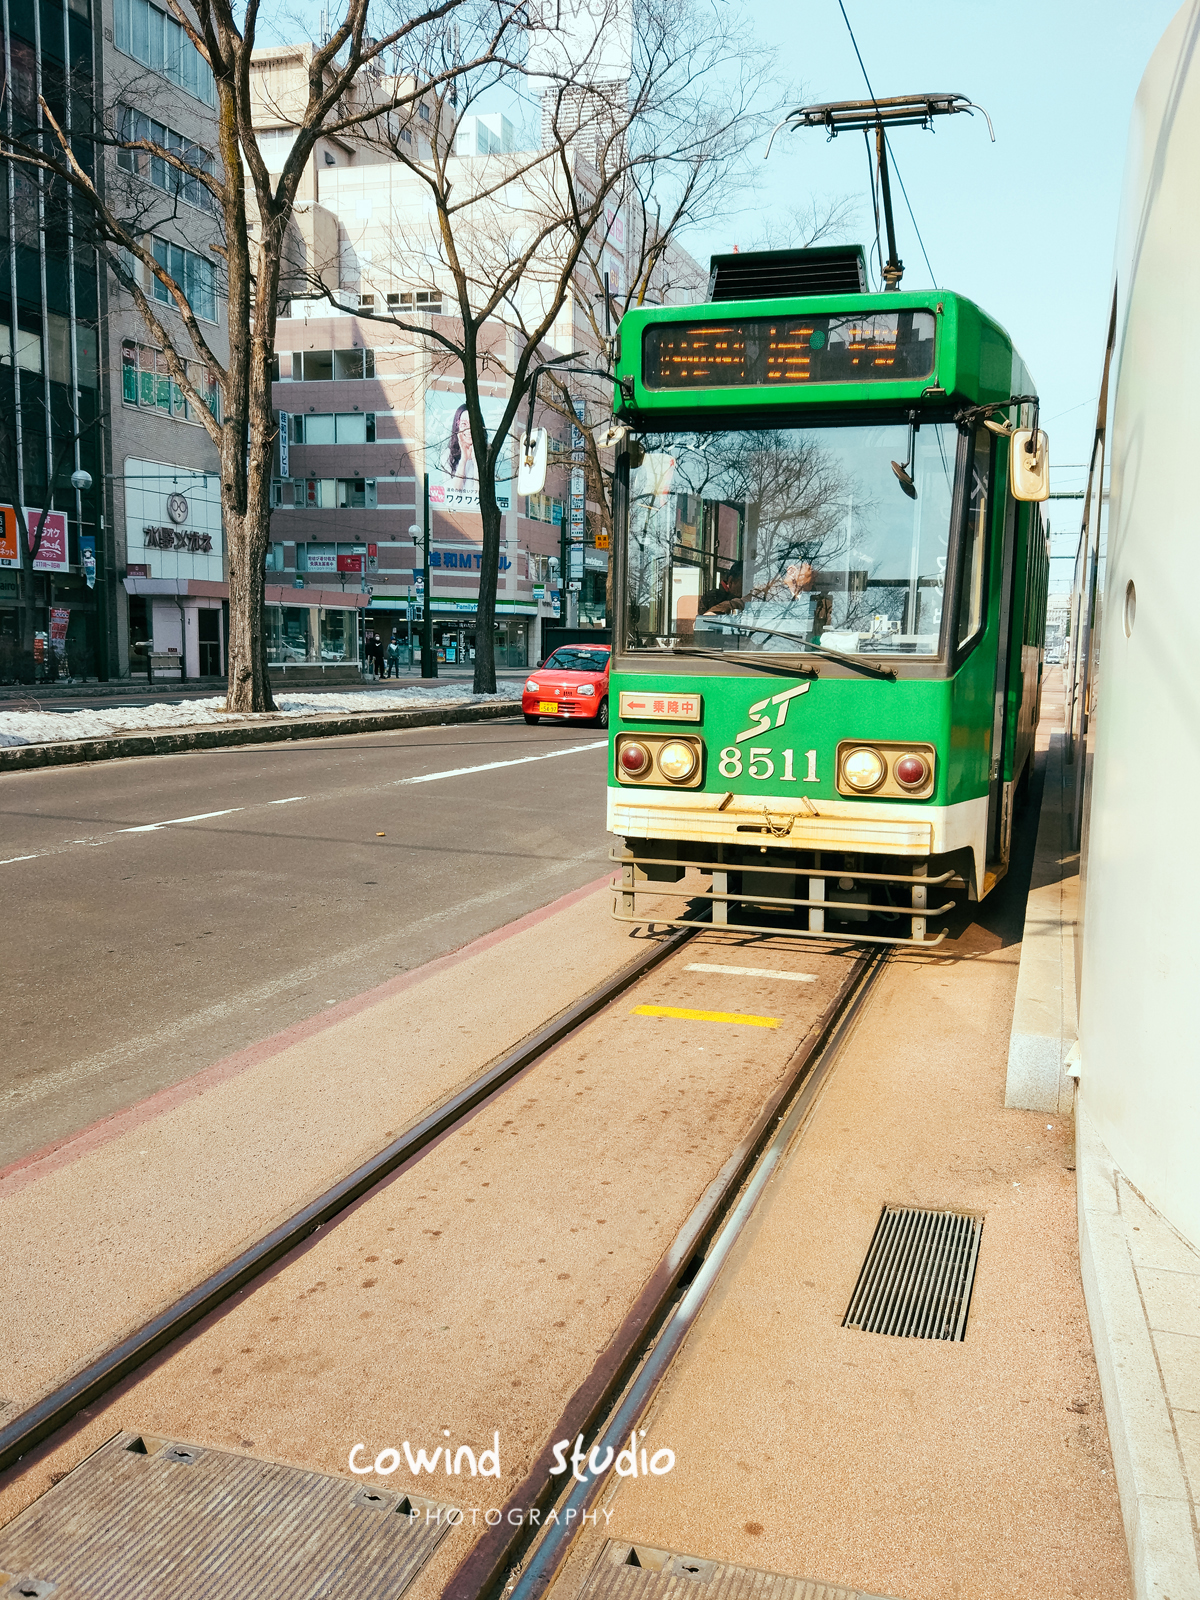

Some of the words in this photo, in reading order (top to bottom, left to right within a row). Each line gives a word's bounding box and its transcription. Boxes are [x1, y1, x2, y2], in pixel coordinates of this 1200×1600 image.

[143, 525, 213, 554] 水野メガネ
[429, 551, 511, 570] 桂和MTル
[458, 630, 466, 663] FamilyMart
[653, 700, 694, 715] 乗降中
[718, 746, 821, 783] 8511
